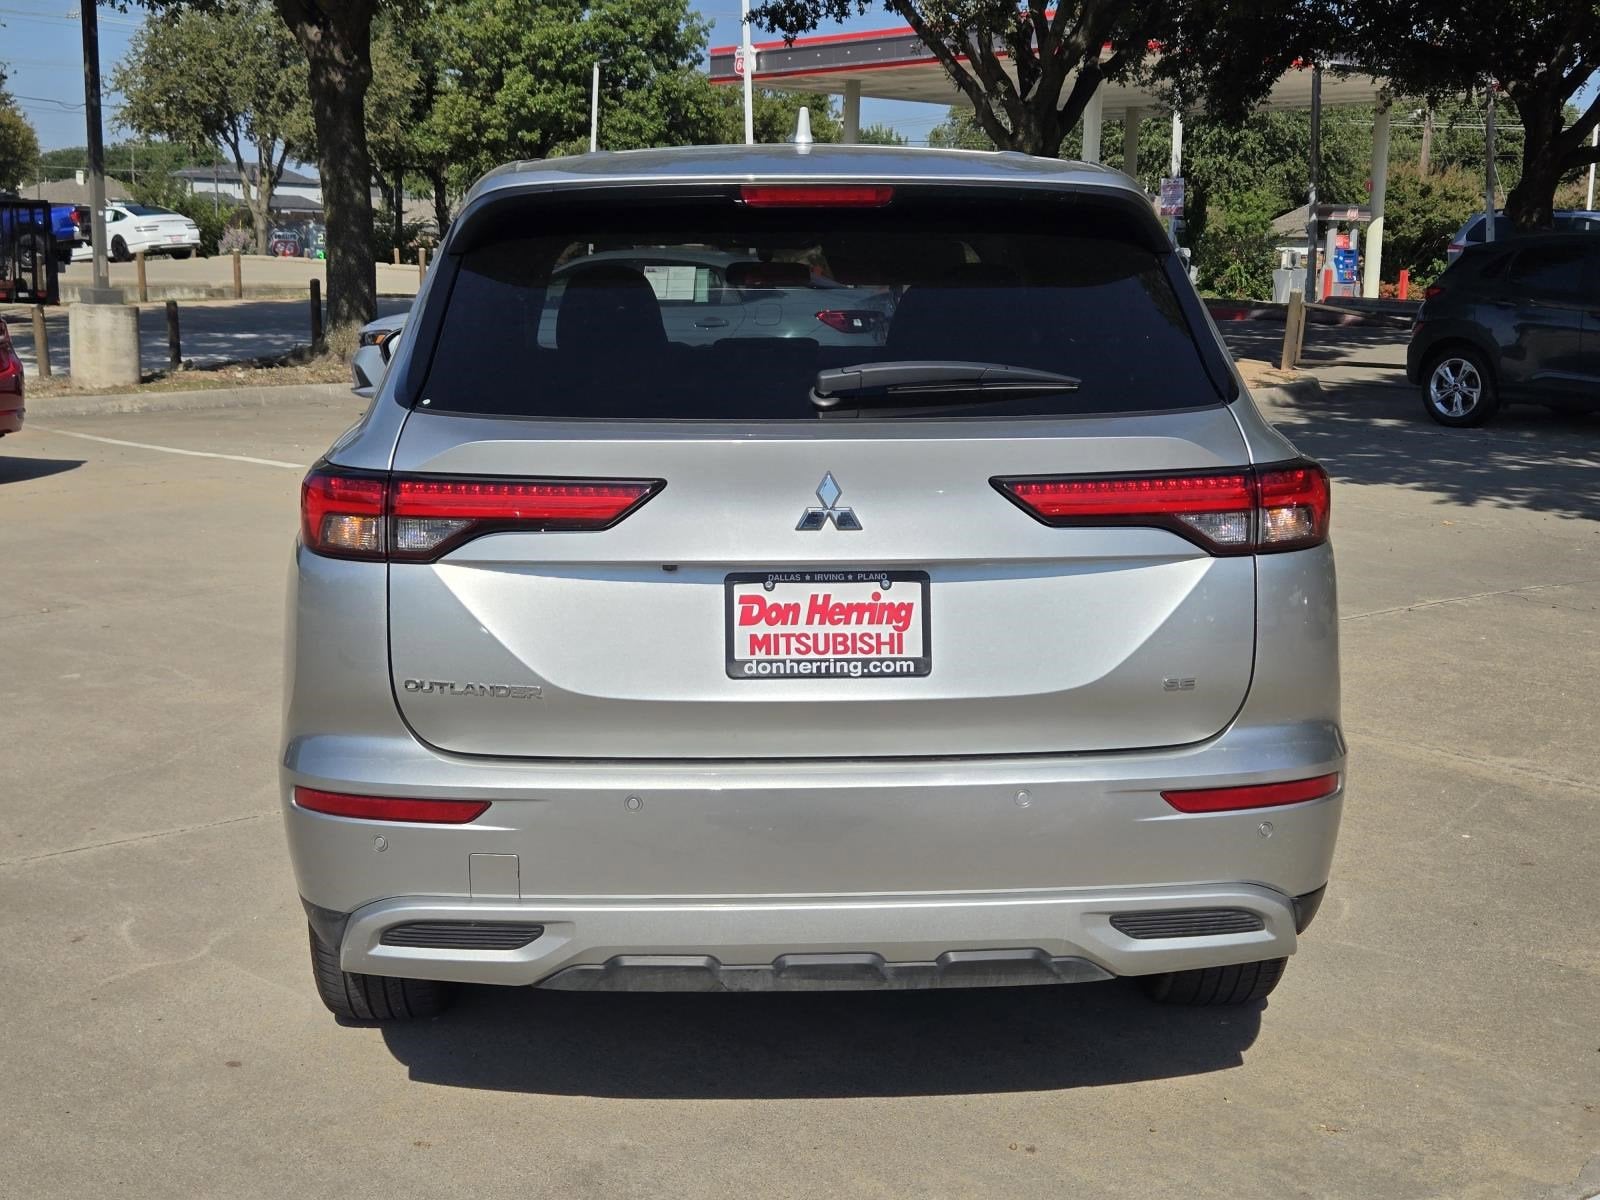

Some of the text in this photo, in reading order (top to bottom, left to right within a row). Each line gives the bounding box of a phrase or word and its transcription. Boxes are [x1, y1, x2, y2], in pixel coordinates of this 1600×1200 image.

[814, 573, 845, 581] IRVING
[738, 591, 914, 632] Don Herring
[749, 632, 904, 656] MITSUBISHI
[743, 658, 915, 676] donherring.com
[404, 679, 543, 699] OUTLANDER
[1163, 677, 1196, 691] SE
